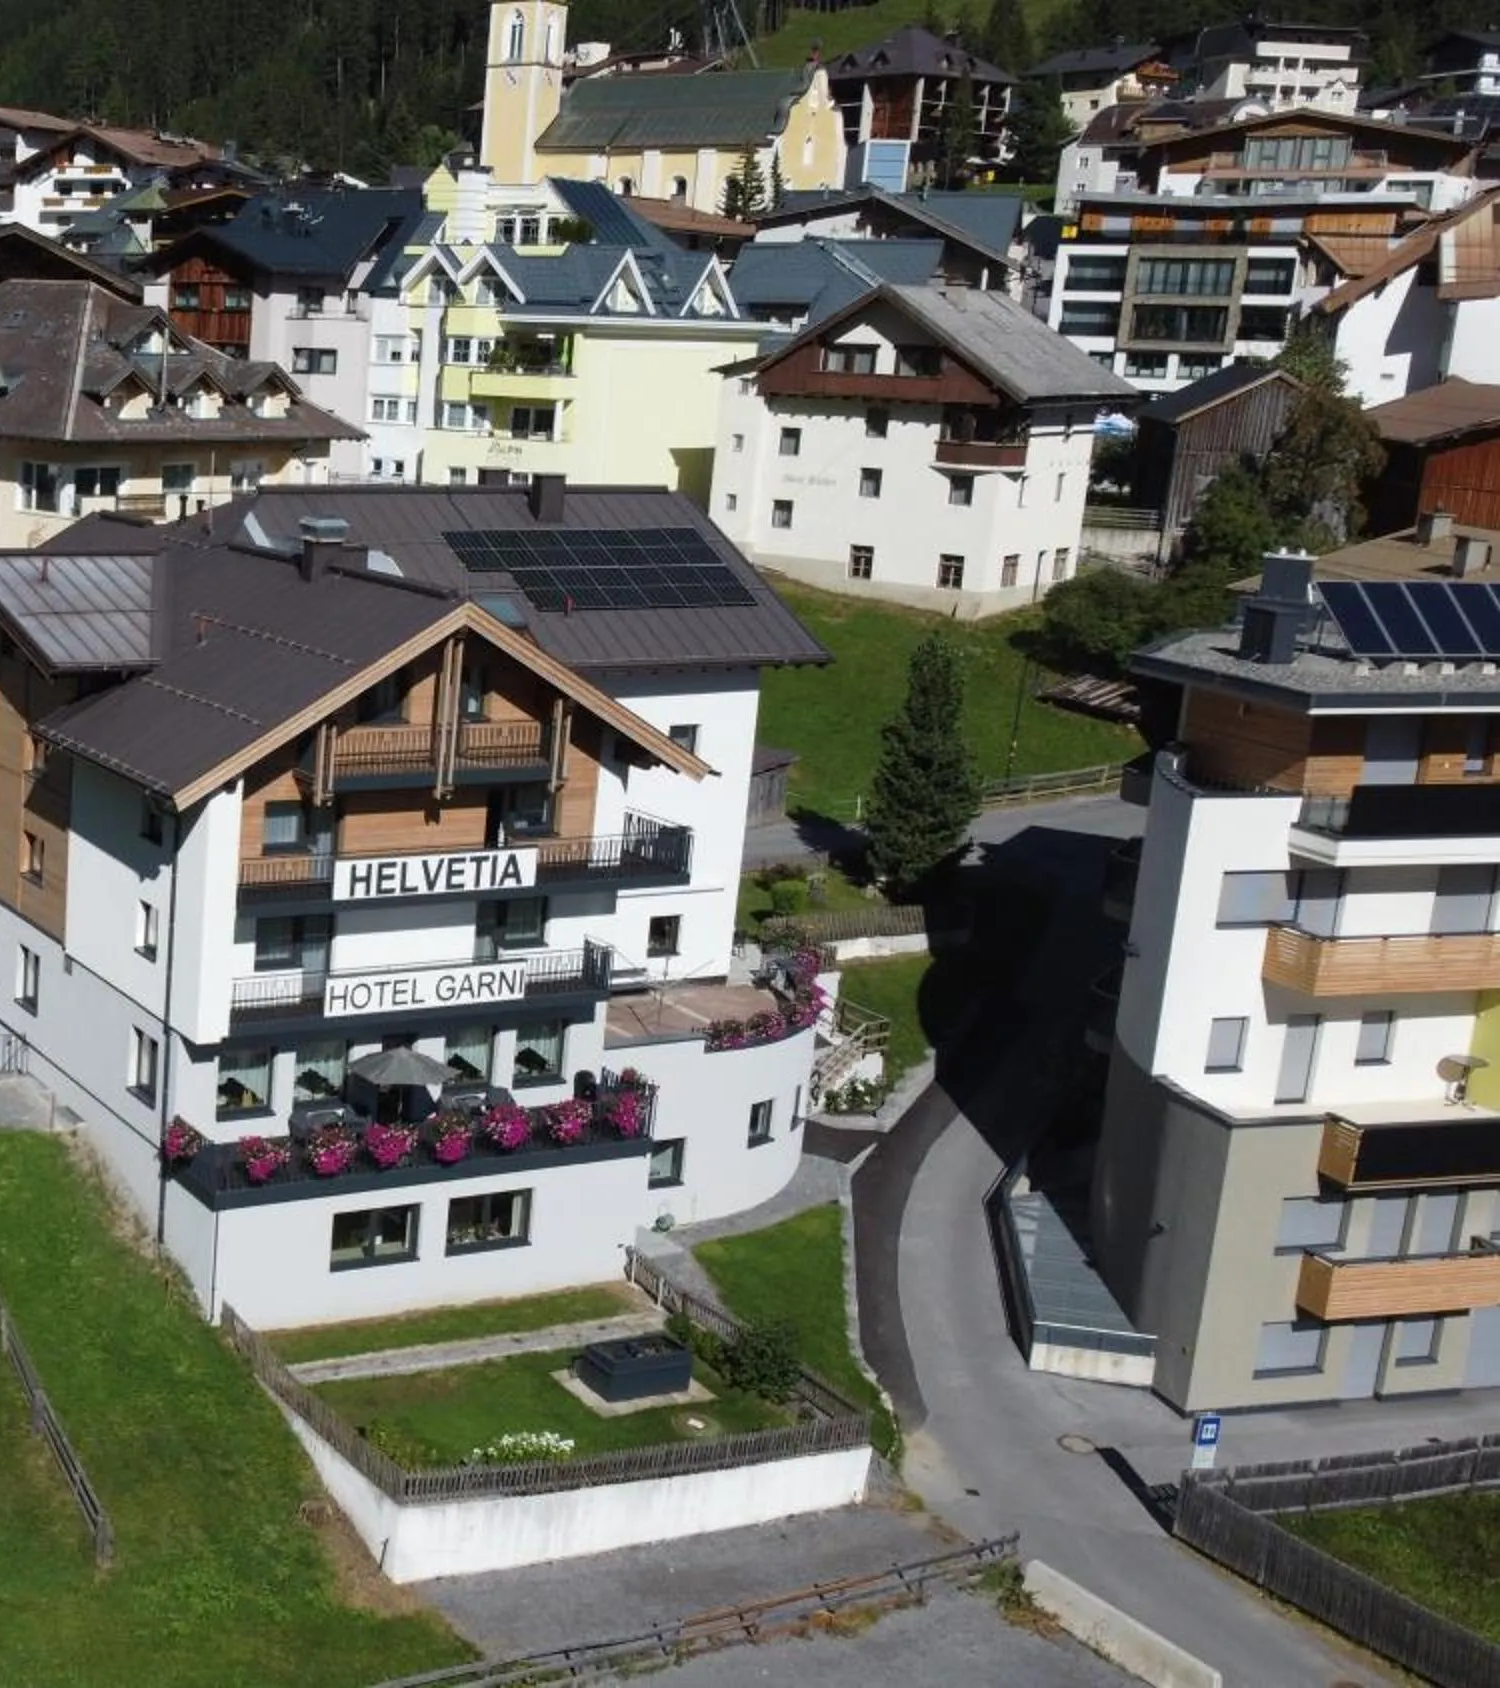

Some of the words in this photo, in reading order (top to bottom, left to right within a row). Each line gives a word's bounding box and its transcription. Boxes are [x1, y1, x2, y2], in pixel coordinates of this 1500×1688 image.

[350, 853, 522, 896] HELVETIA
[329, 978, 425, 1013] HOTEL
[435, 969, 524, 1000] GARNI
